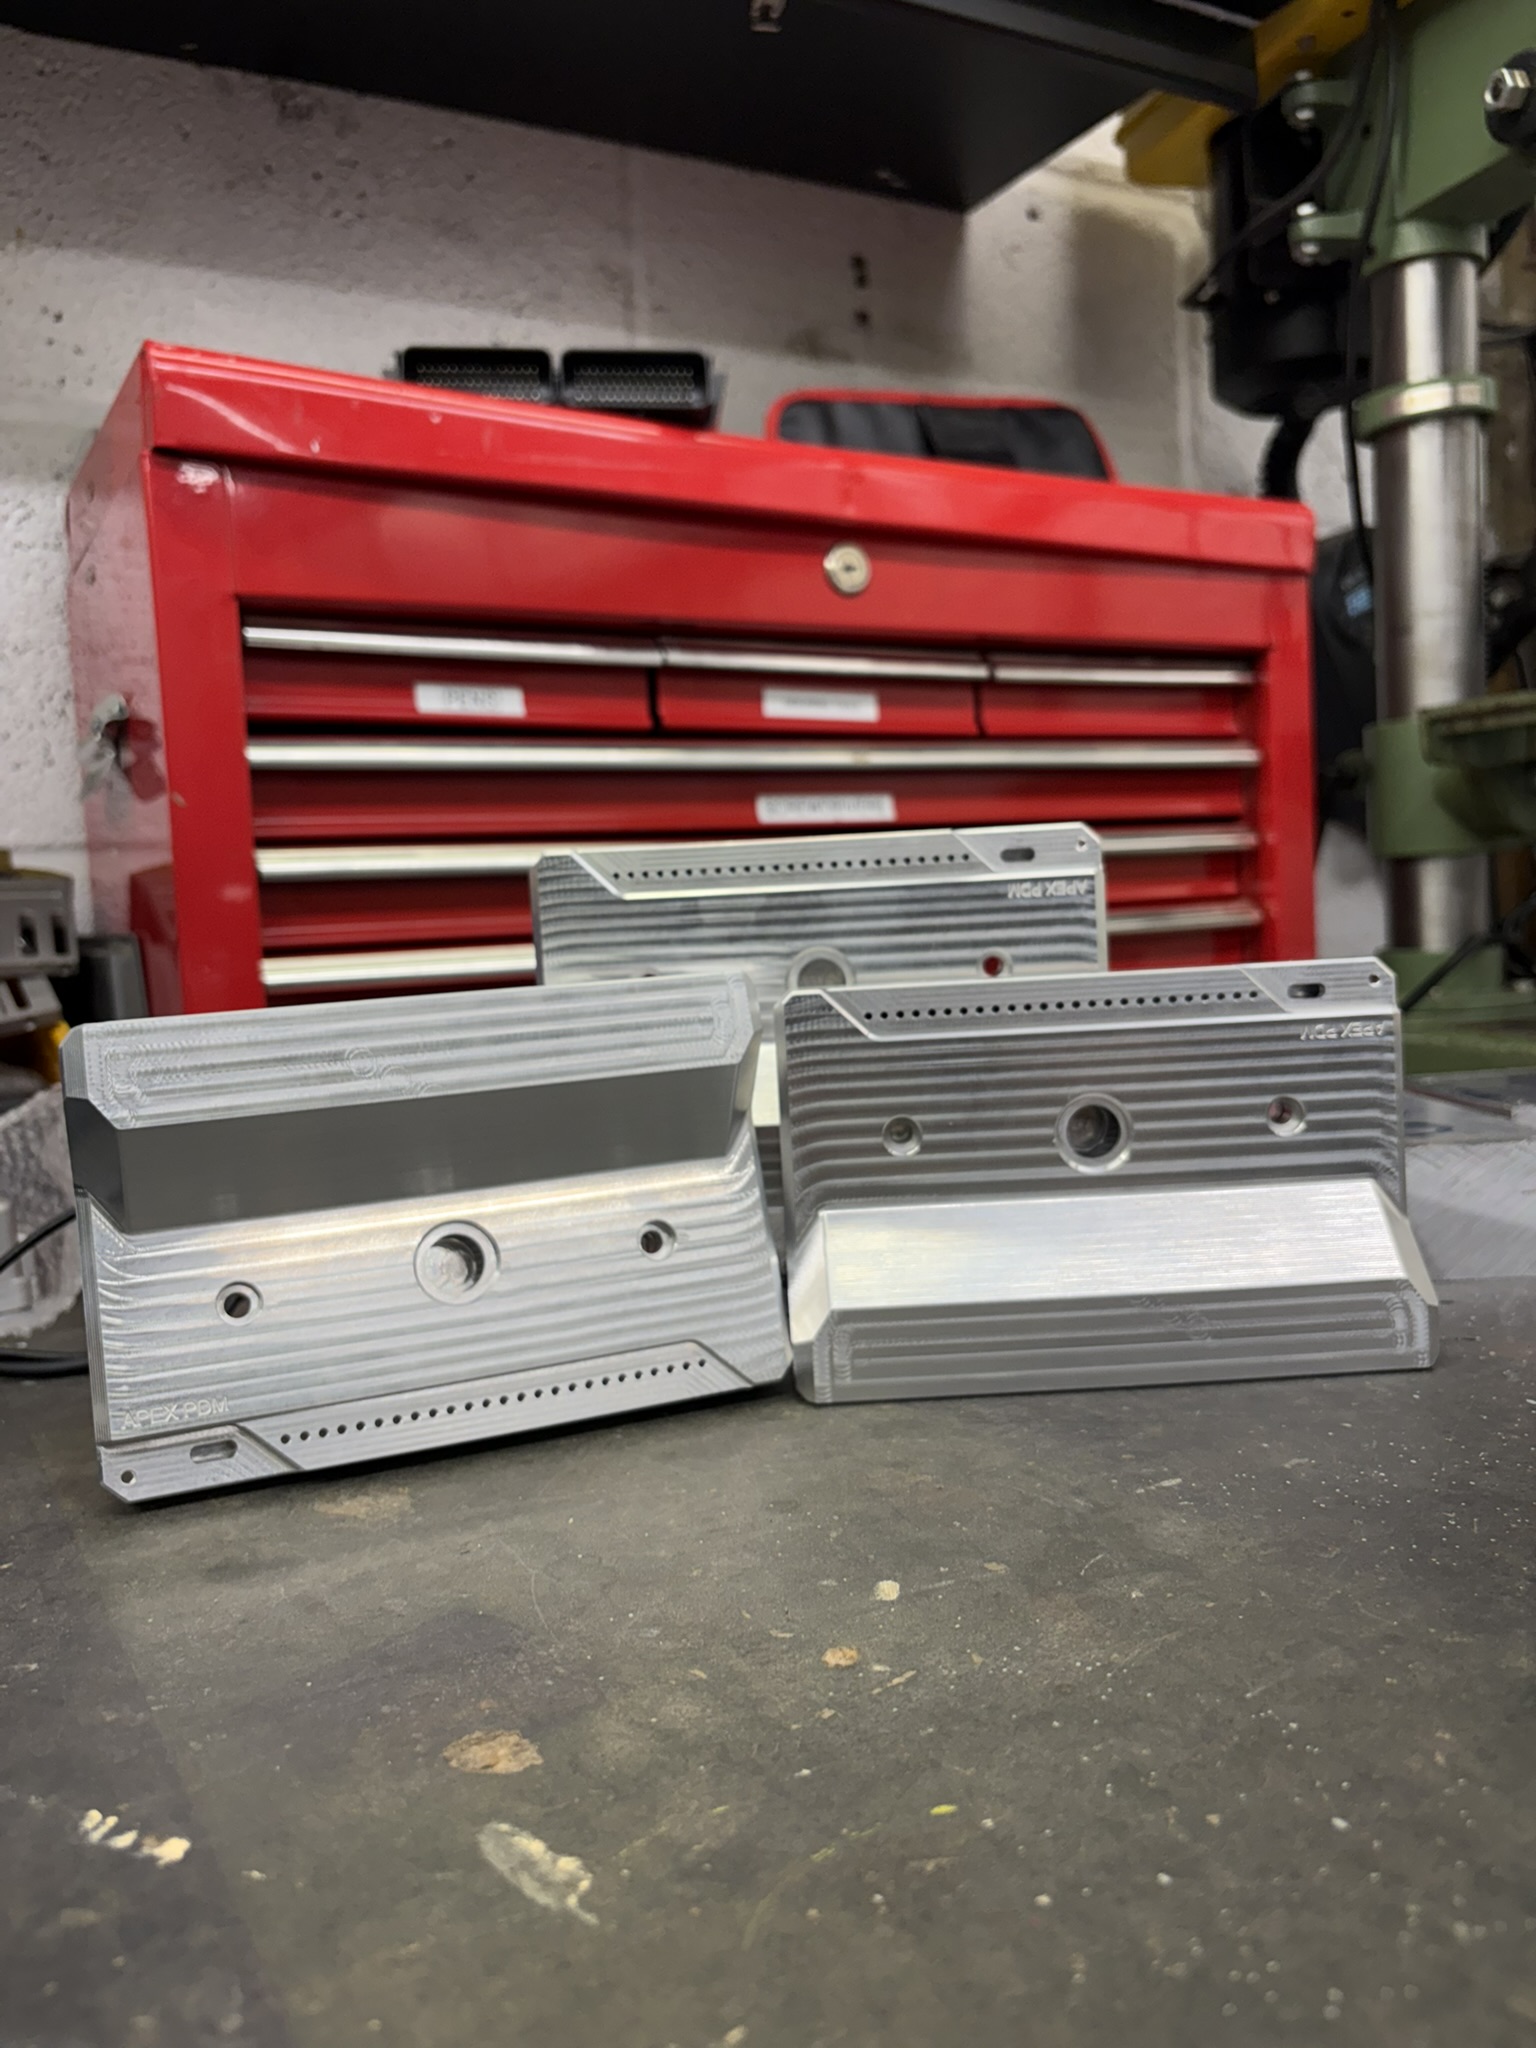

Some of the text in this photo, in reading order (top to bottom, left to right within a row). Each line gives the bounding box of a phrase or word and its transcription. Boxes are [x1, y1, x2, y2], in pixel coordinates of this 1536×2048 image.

[1007, 879, 1088, 899] APEX PDM
[1340, 1021, 1385, 1039] APEX
[120, 1397, 230, 1431] APEX PDM
